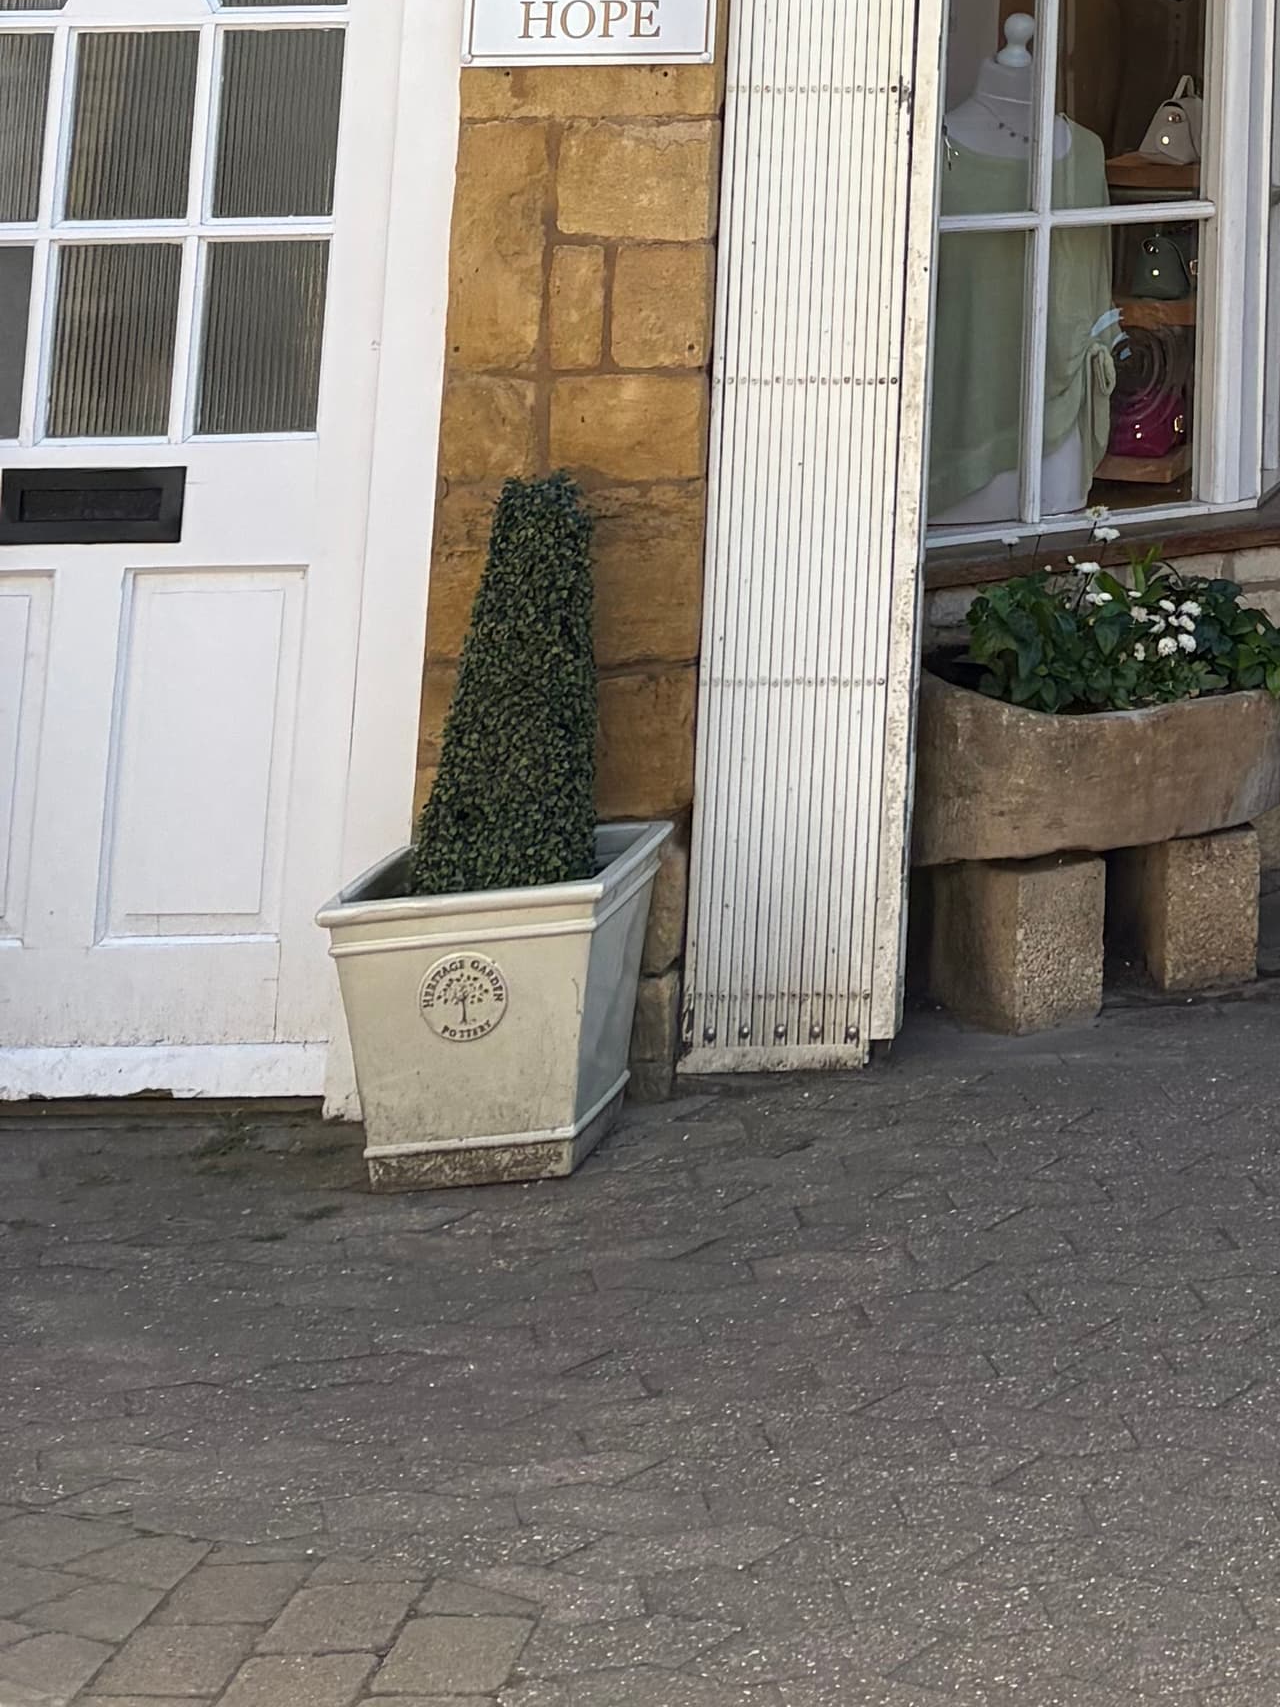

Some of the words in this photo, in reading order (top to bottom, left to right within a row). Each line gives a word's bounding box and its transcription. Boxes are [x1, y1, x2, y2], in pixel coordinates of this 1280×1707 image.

[518, 0, 661, 39] HOPE
[422, 959, 465, 1008] HERITAGE
[470, 960, 504, 1002] GARDEN
[441, 1019, 491, 1038] POTTERY
